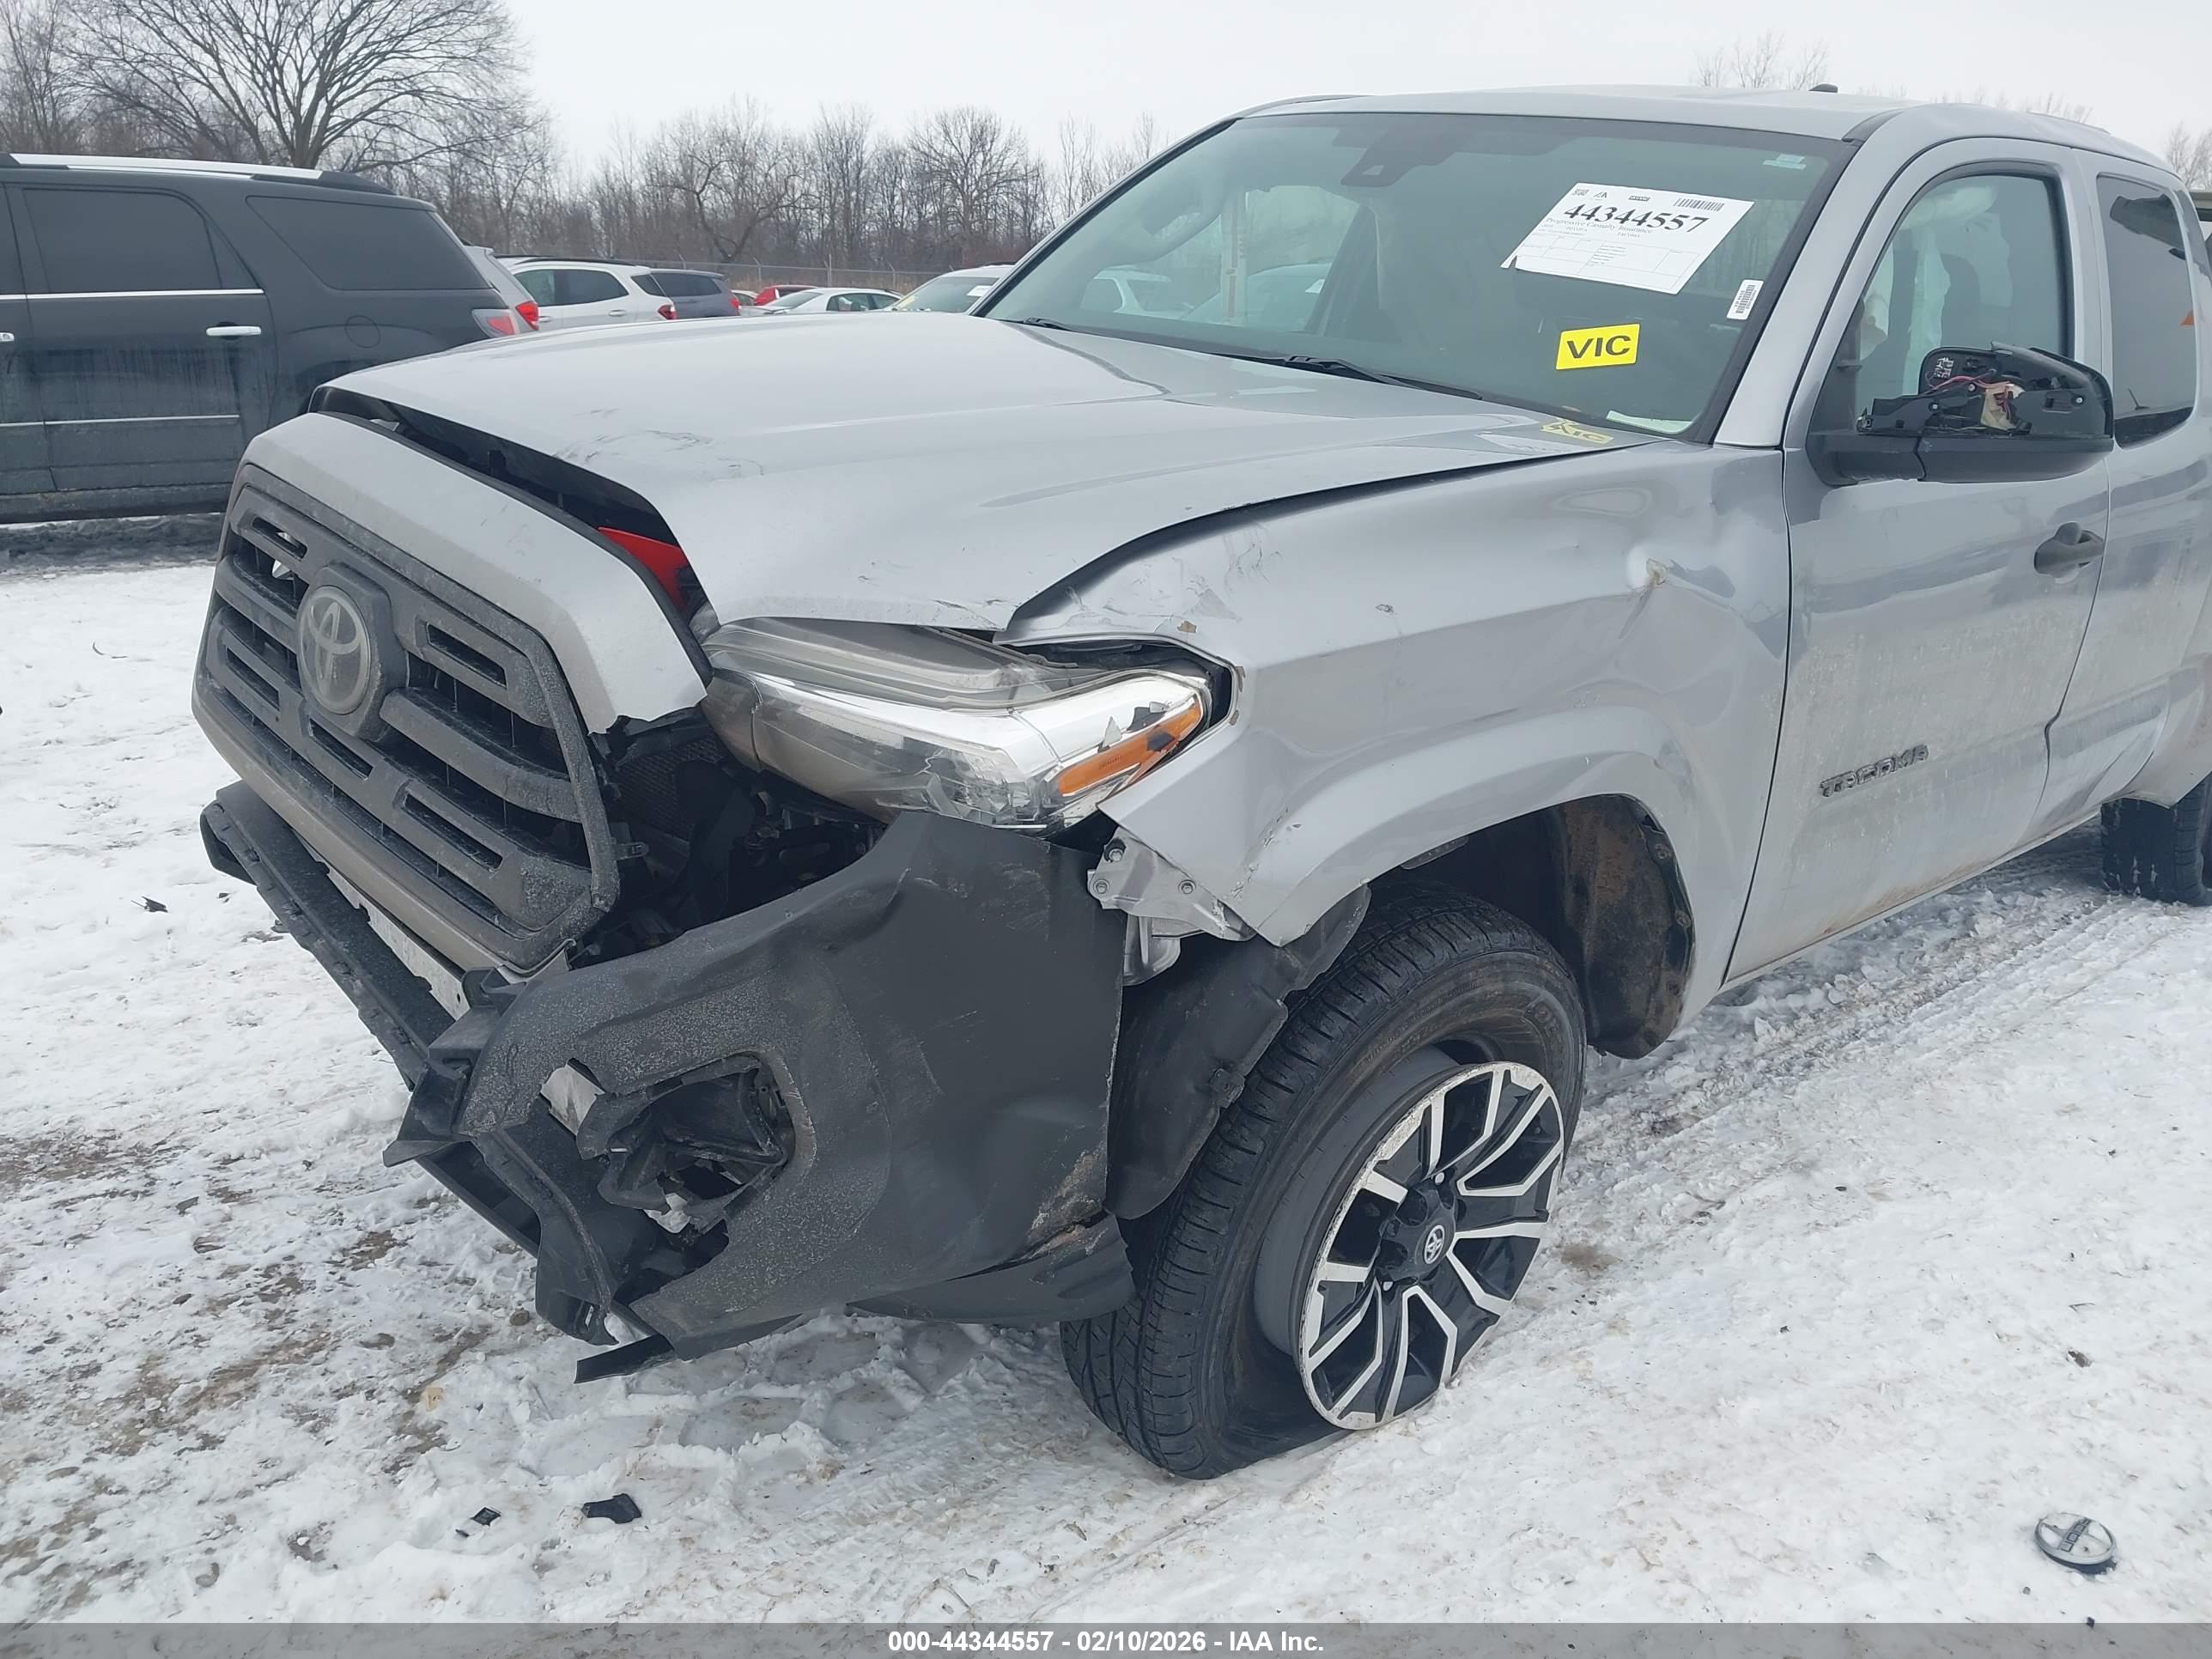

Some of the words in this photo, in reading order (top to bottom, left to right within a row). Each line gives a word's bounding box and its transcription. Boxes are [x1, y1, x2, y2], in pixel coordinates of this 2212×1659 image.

[1564, 204, 1711, 233] 44344557
[1565, 335, 1631, 359] VIC
[1820, 744, 1929, 798] TACOMA
